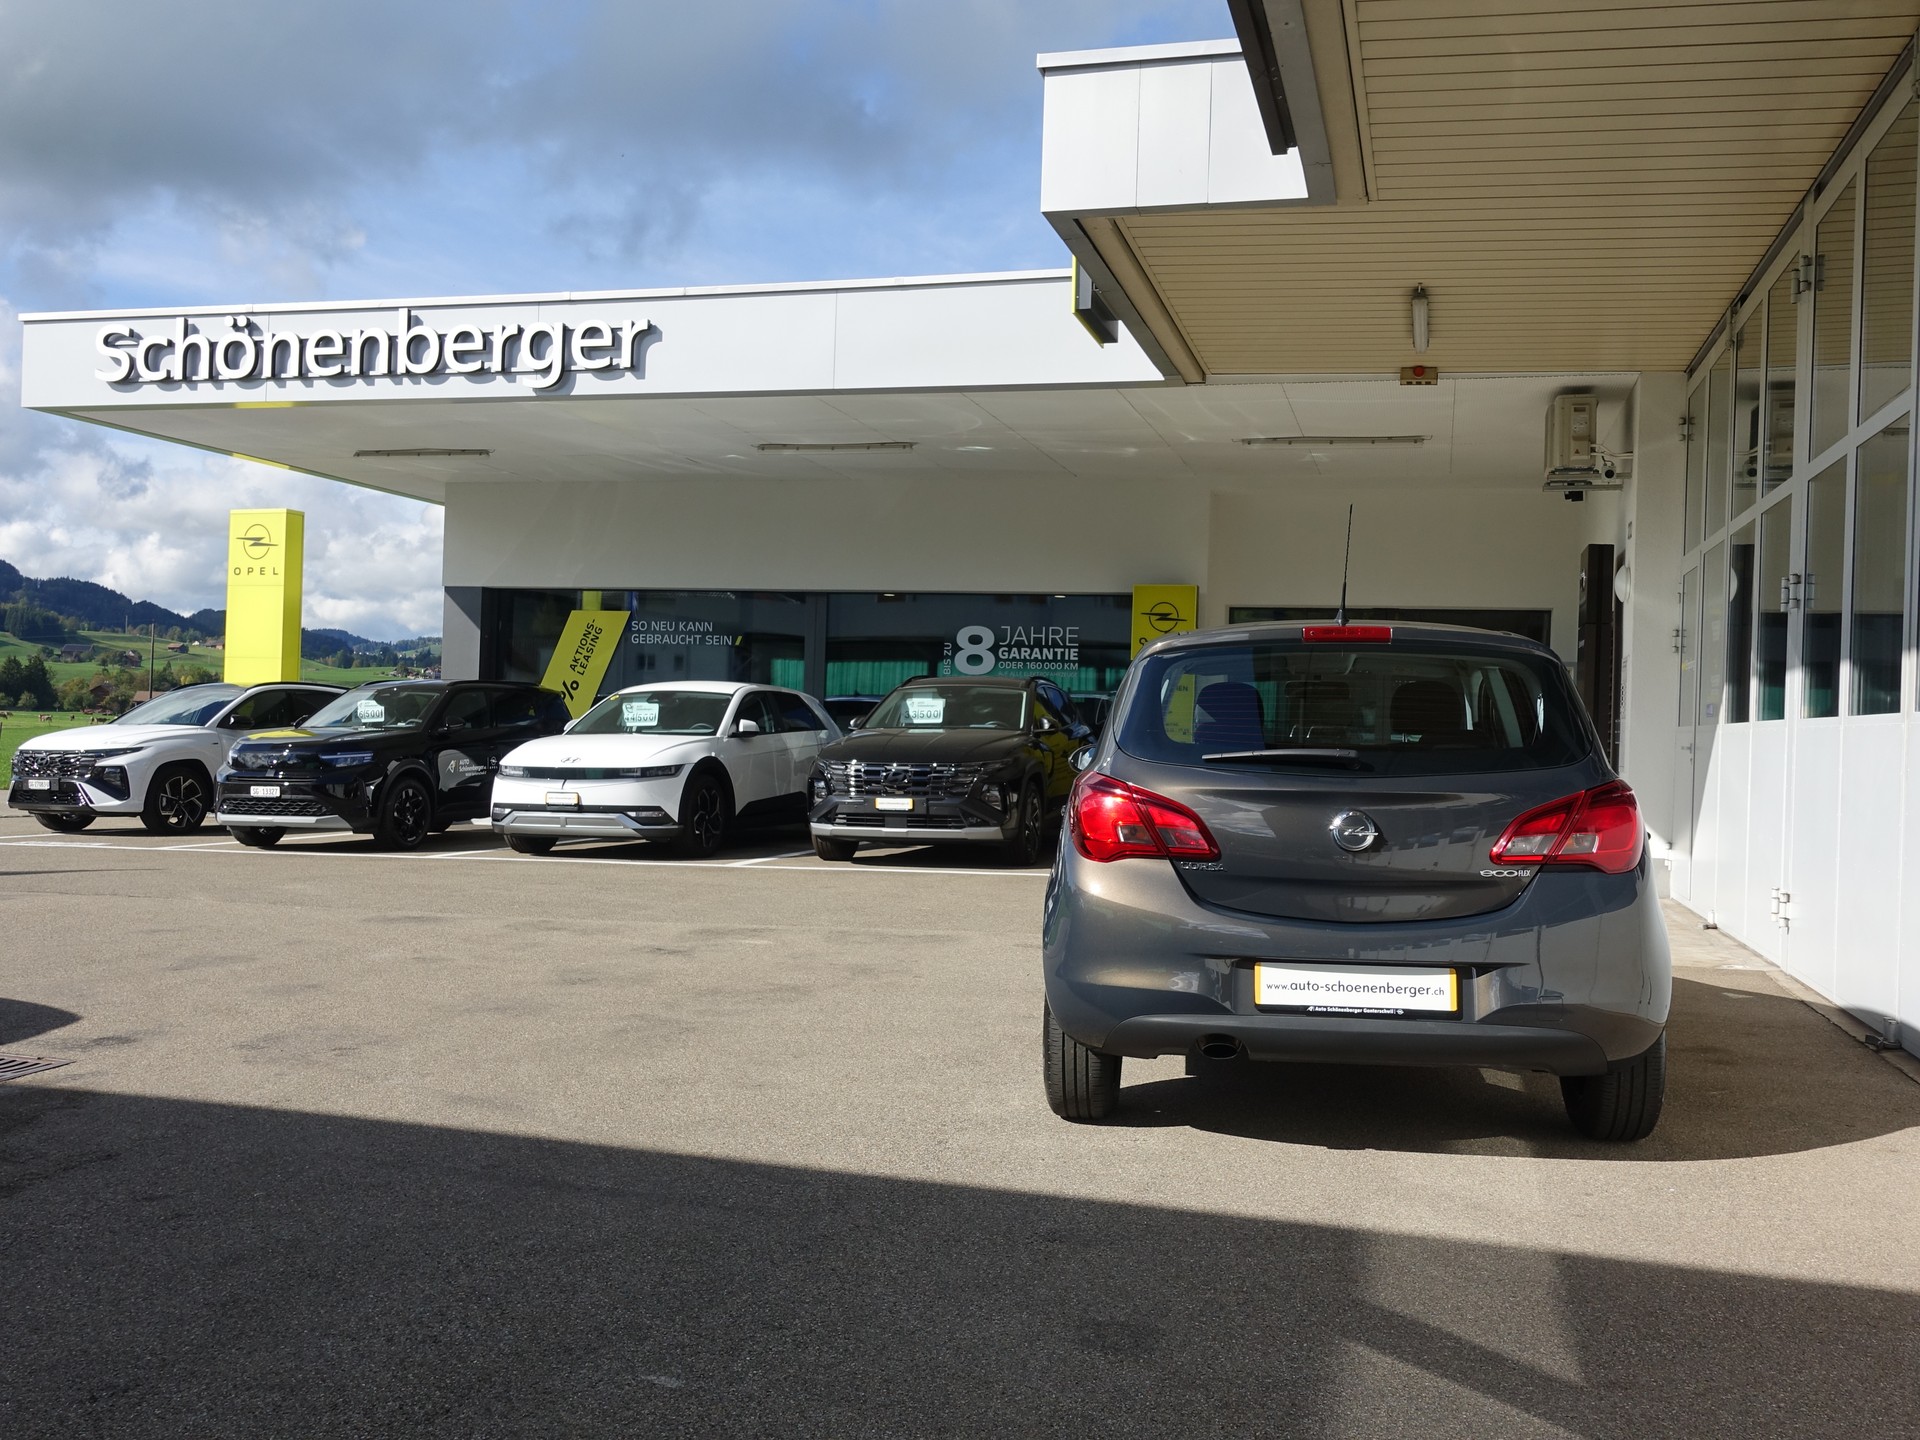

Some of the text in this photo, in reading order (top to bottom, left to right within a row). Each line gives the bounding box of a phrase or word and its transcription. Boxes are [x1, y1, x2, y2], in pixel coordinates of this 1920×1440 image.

[95, 308, 656, 389] Schönenberger
[233, 566, 279, 576] OPEL
[631, 620, 713, 632] SO NEU KANN
[631, 634, 732, 646] GEBRAUCHT SEIN
[999, 625, 1080, 646] JAHRE
[569, 618, 596, 672] AKTIONS-
[577, 627, 603, 676] LEASING
[954, 625, 996, 676] 8
[998, 647, 1079, 661] GARANTIE
[943, 642, 952, 675] BIS ZU
[998, 661, 1023, 670] ODER
[1064, 662, 1079, 671] KM
[1180, 861, 1225, 871] CORSA
[1266, 980, 1445, 998] www.auto-schoenenberger.ch
